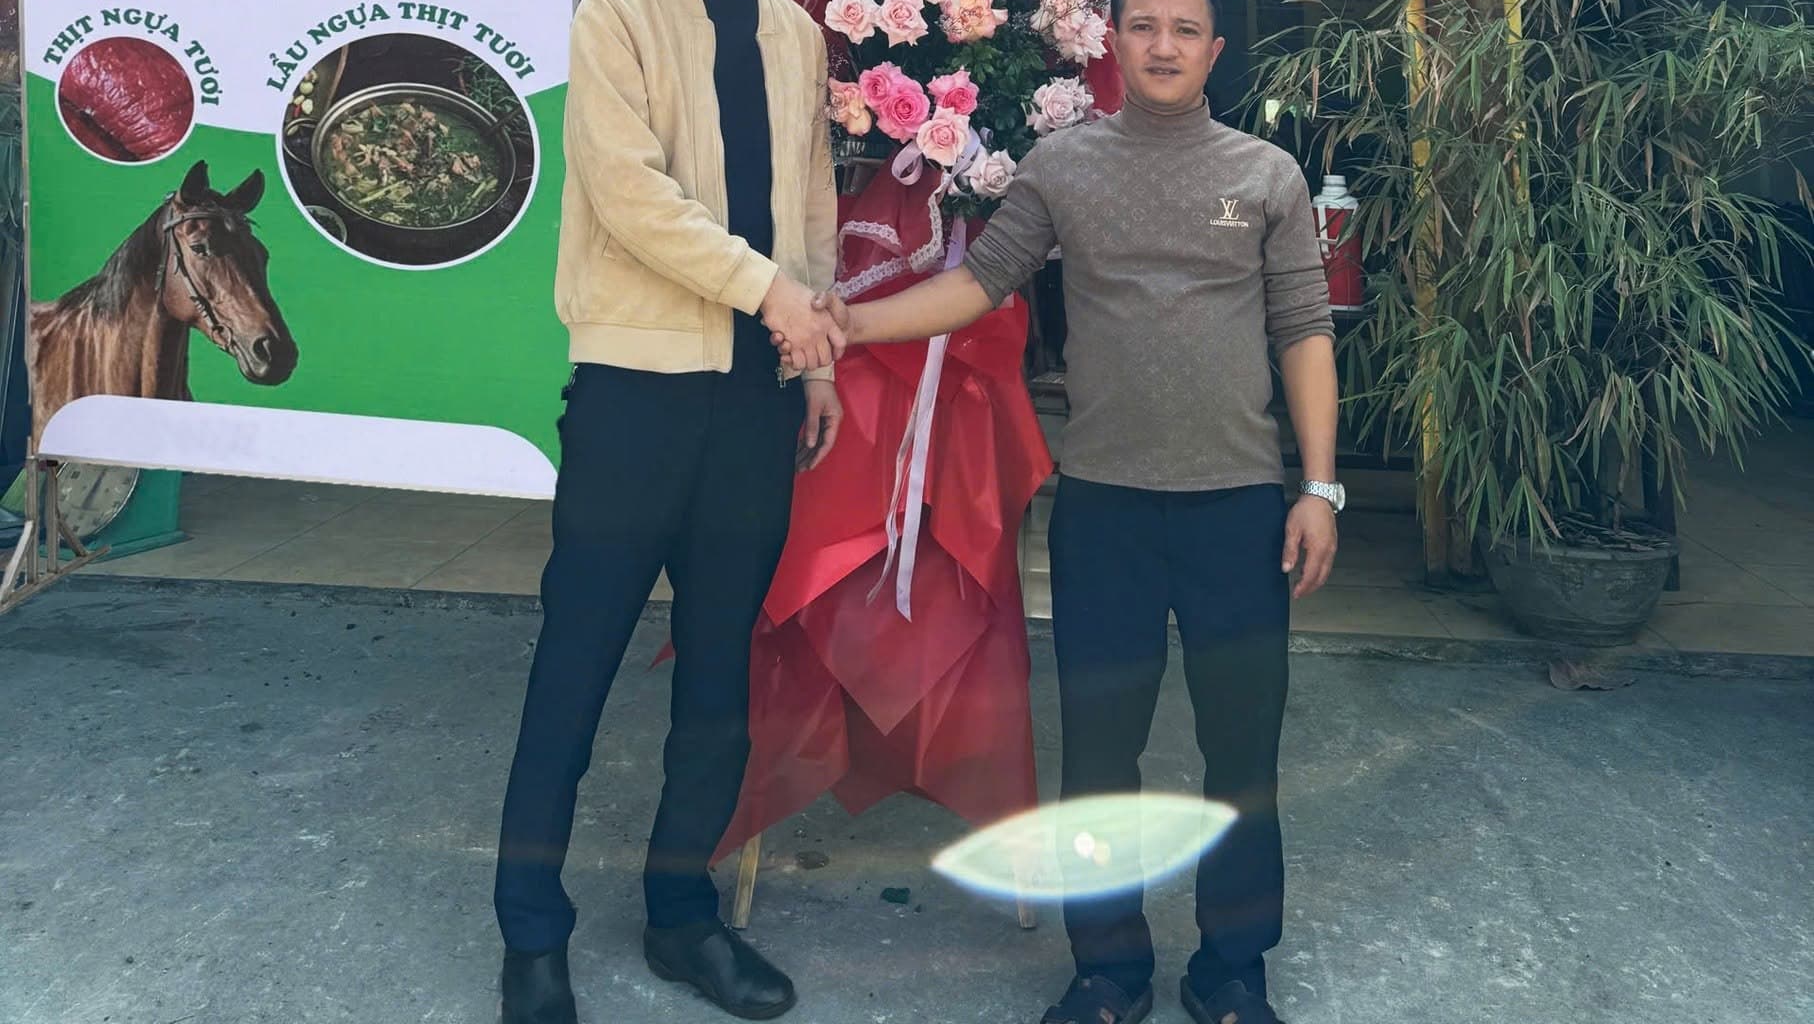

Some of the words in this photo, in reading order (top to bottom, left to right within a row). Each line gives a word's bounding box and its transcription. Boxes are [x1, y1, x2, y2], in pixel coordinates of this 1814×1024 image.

[42, 15, 94, 66] THỊT
[100, 8, 181, 43] NGỰA
[184, 40, 223, 106] TƯƠI
[266, 40, 309, 92] LẨU
[307, 2, 391, 45] NGỰA
[397, 2, 469, 30] THỊT
[472, 23, 536, 80] TƯƠI
